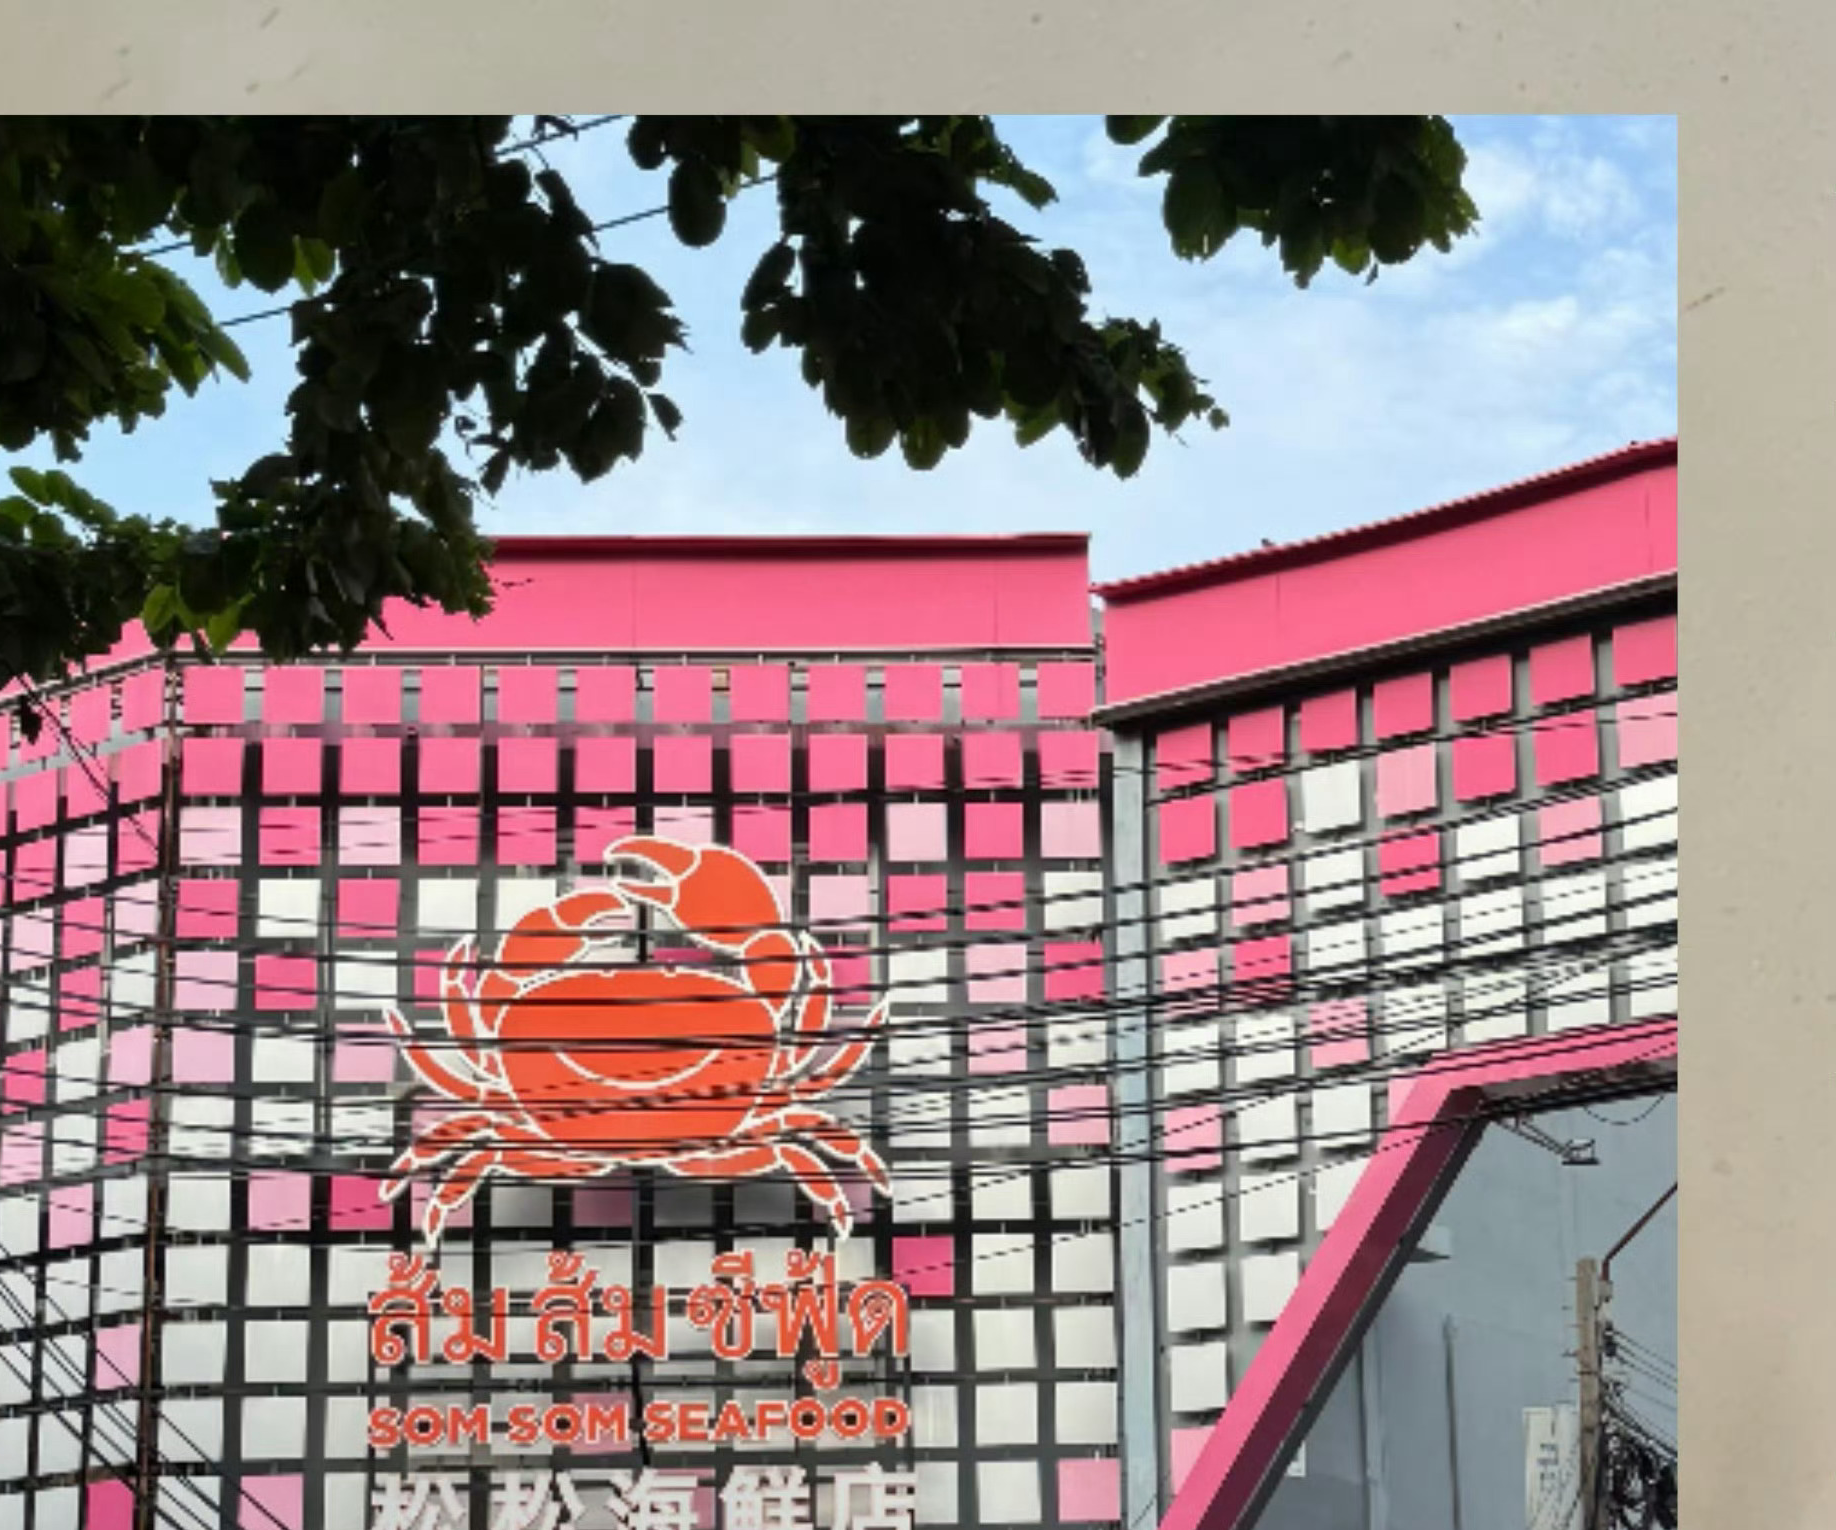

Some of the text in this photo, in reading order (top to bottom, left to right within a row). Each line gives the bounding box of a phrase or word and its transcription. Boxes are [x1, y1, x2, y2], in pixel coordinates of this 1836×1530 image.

[368, 1249, 910, 1390] ส้ม ส้ม ซีฟู้ด
[368, 1396, 912, 1449] SOM SOM SEAFOOD
